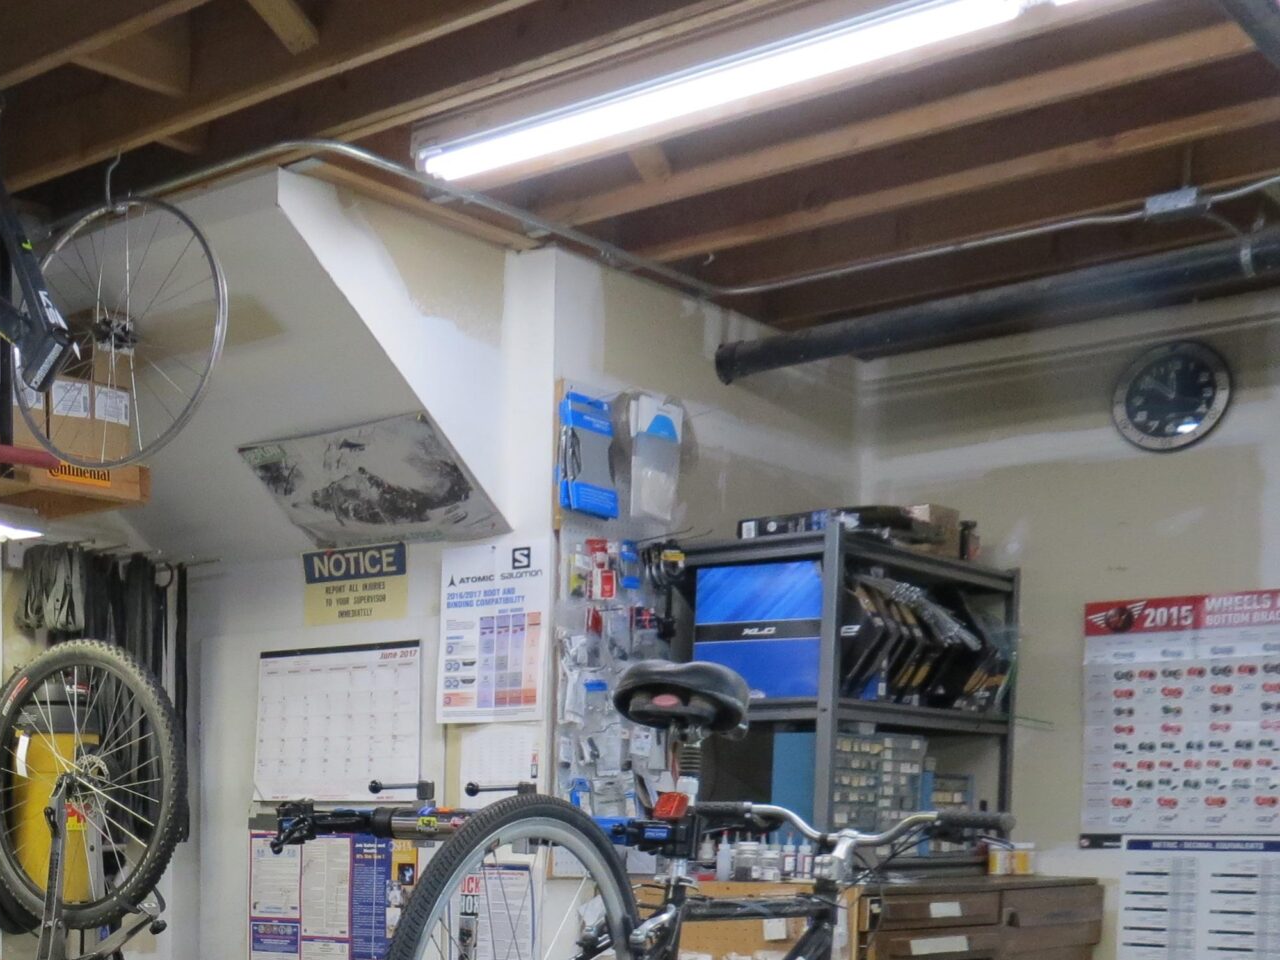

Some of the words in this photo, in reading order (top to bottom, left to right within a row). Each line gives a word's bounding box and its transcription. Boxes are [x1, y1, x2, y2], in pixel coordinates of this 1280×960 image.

[313, 548, 397, 578] NOTICE
[459, 574, 495, 584] ATOMIC
[325, 584, 346, 594] REPORT
[349, 583, 359, 592] ALL
[362, 581, 385, 591] INJURIES
[483, 588, 500, 597] BOOT
[502, 587, 516, 595] AND
[325, 598, 333, 607] TO
[336, 597, 350, 606] YOUR
[353, 594, 386, 605] SUPERVISOR
[446, 600, 474, 609] BINDING
[475, 595, 525, 607] COMPATIBILITY
[338, 608, 373, 618] IMMEDIATELY
[1144, 605, 1194, 628] 2015
[1204, 593, 1271, 612] WHEELS
[1207, 614, 1250, 625] BOTTOM
[379, 651, 398, 660] June
[399, 649, 418, 659] 2017
